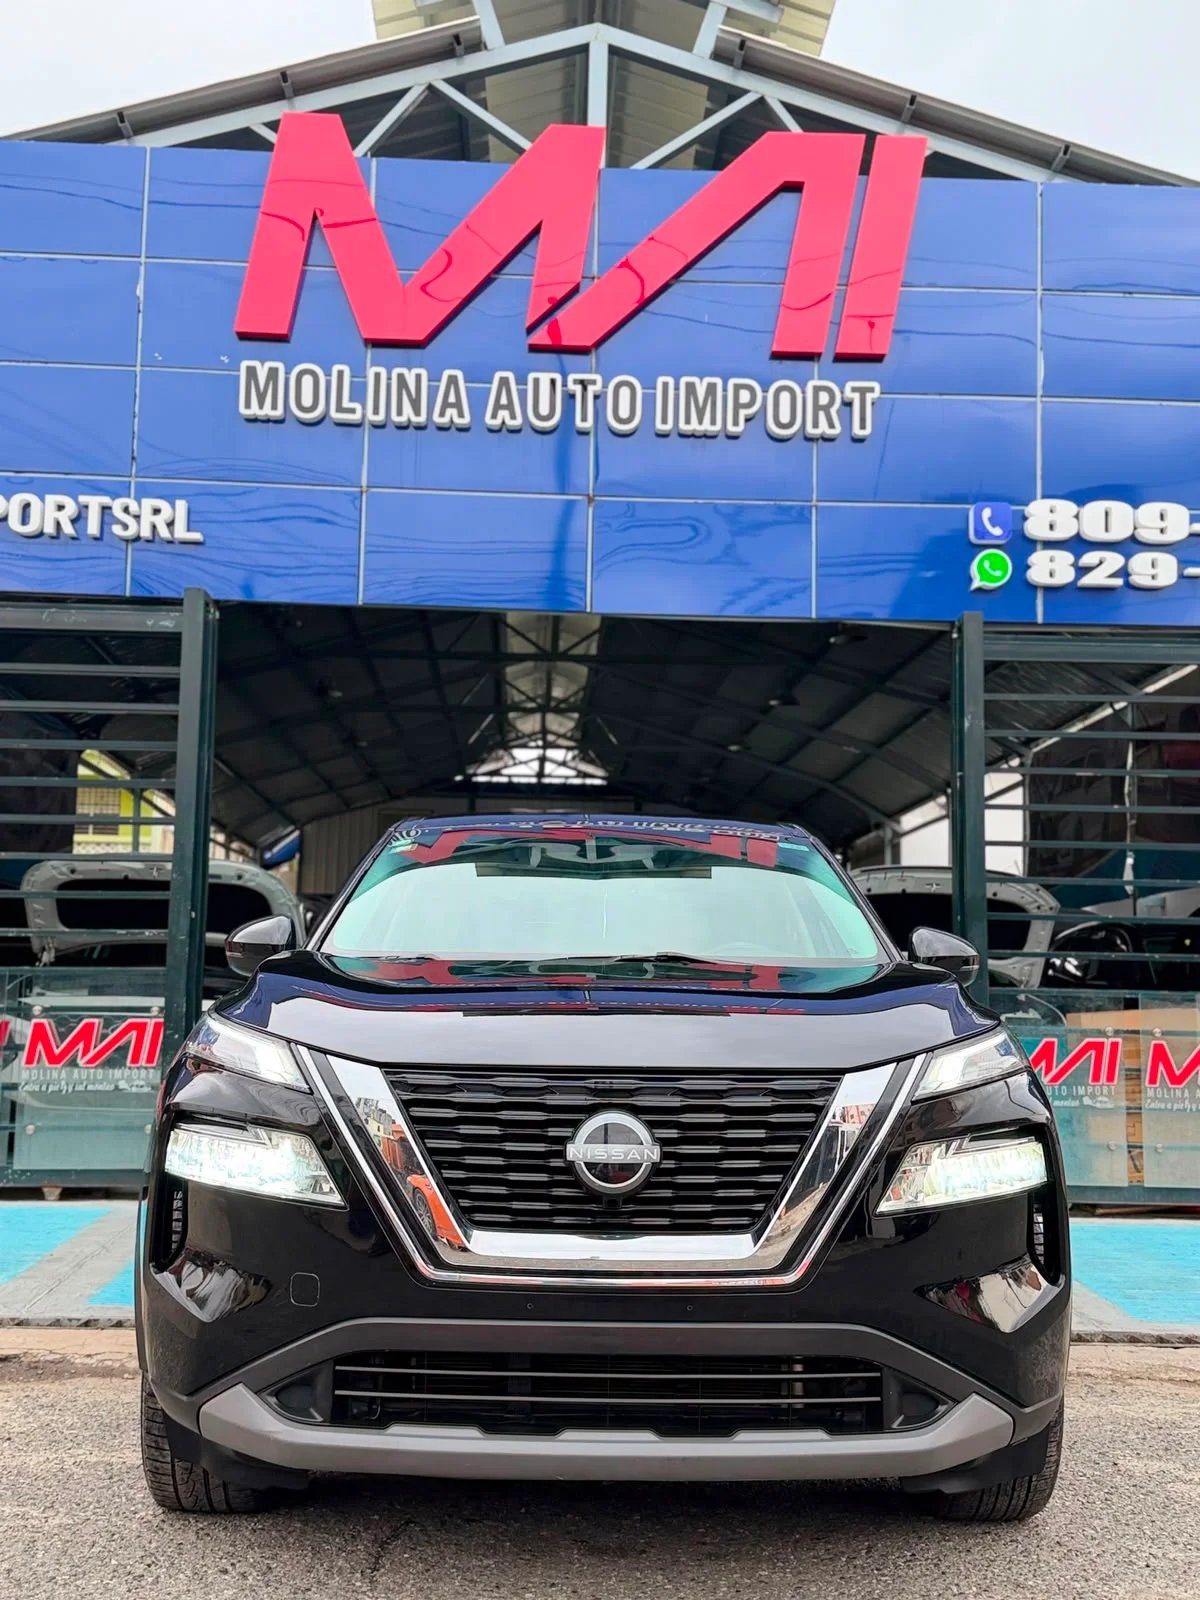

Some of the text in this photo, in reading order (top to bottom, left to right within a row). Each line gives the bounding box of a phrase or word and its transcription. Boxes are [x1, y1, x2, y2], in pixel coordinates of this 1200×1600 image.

[238, 360, 881, 441] MOLINA AUTO IMPORT
[0, 492, 204, 543] ORTSRL
[22, 1018, 164, 1068] MAI
[21, 1068, 155, 1080] MOLINA AUTO IMPORT
[1046, 1085, 1116, 1096] UTO IMPORT
[1147, 1088, 1189, 1098] MOLINA
[569, 1147, 658, 1160] NISSAN
